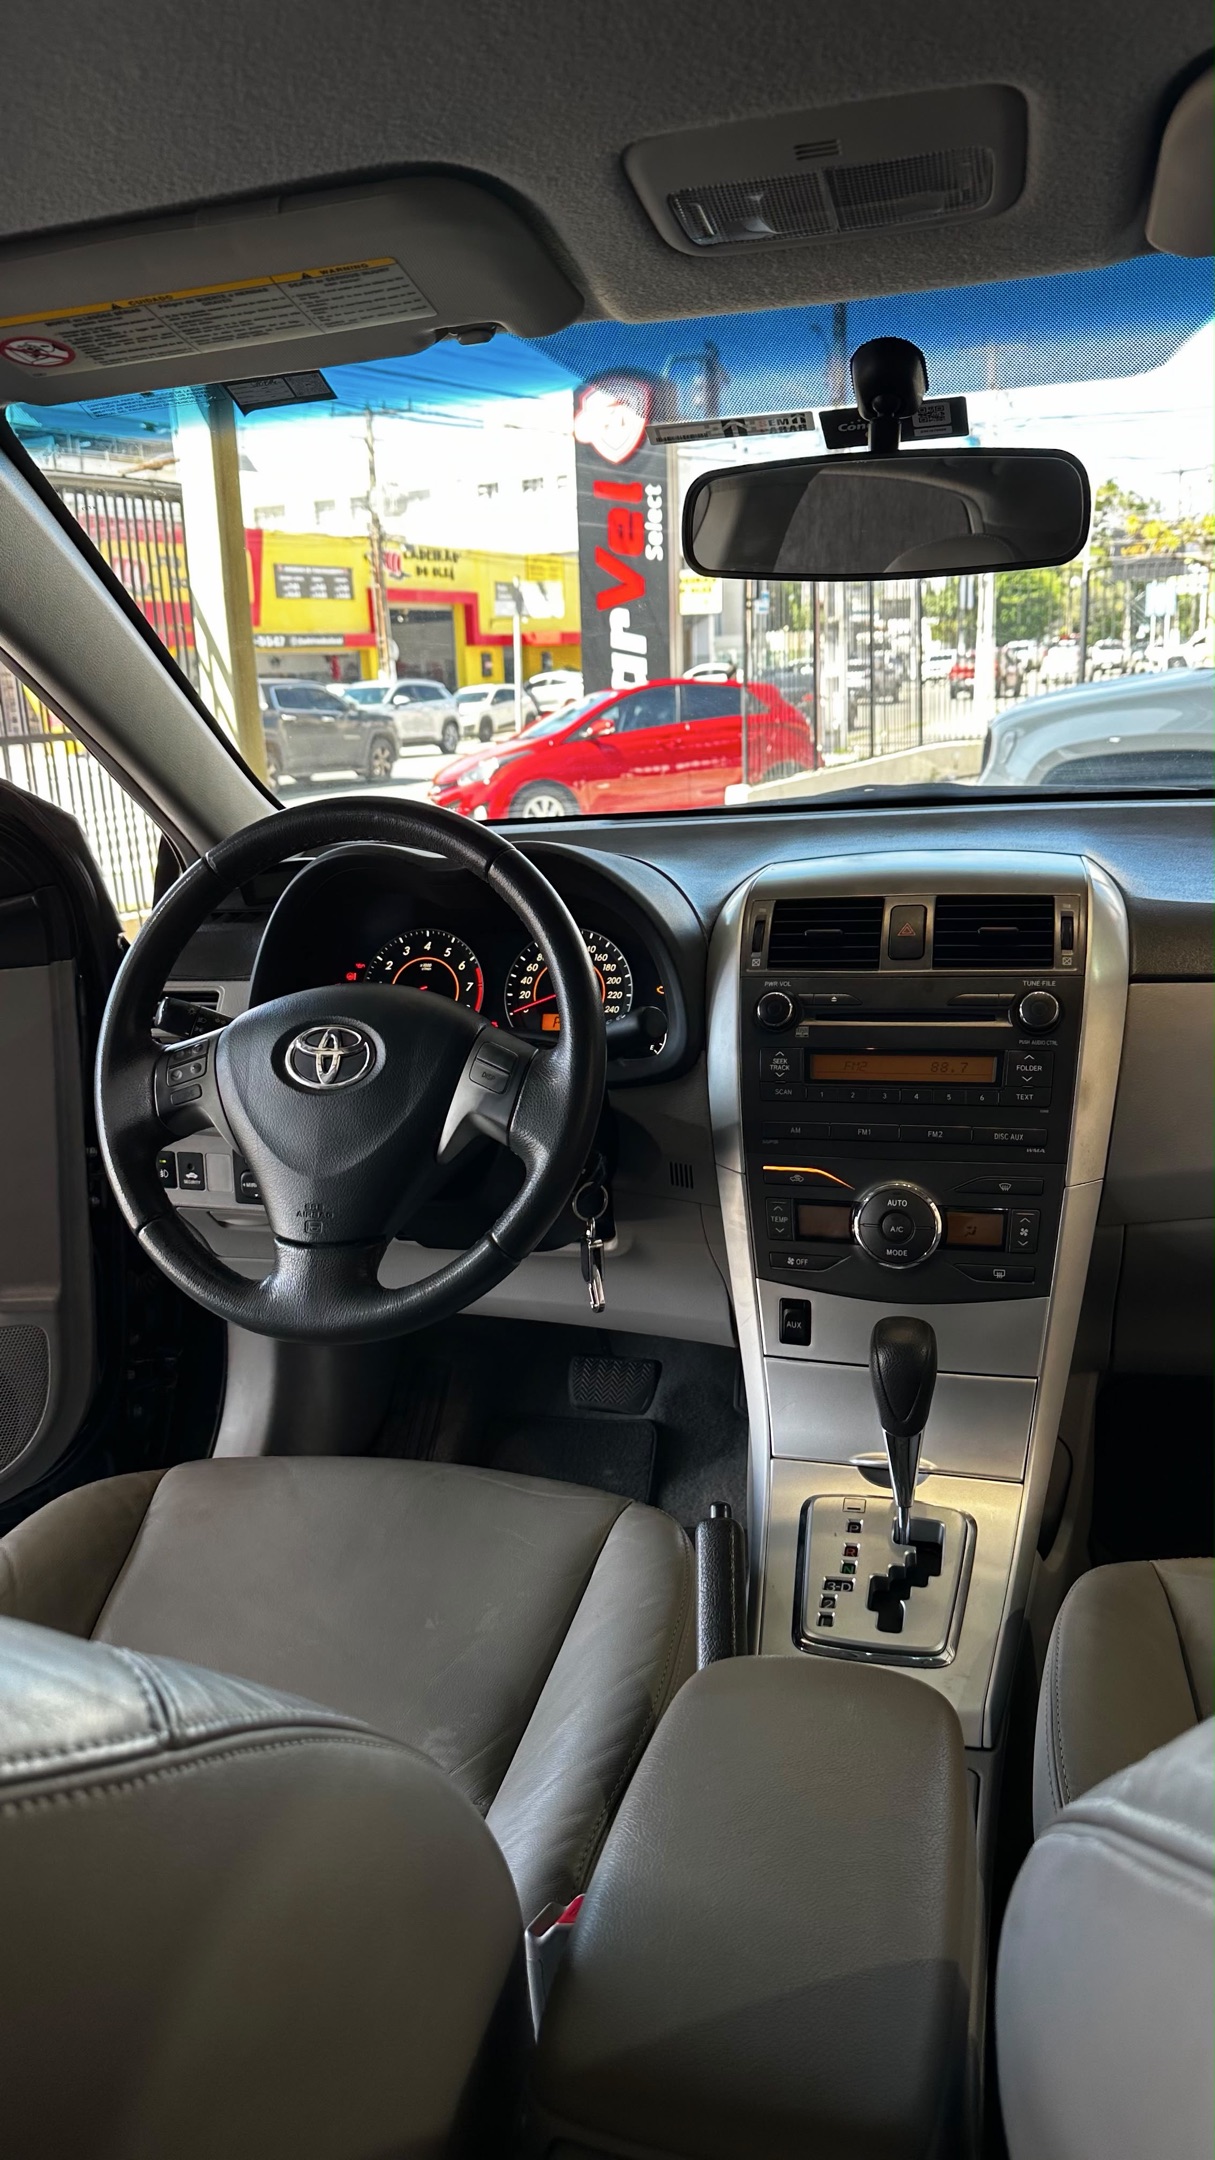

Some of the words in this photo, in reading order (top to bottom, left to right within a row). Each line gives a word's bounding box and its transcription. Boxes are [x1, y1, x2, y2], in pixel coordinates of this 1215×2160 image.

[319, 263, 369, 276] WARNING
[127, 294, 174, 306] CUIDADO
[838, 422, 869, 432] Con
[644, 483, 665, 561] Select
[402, 946, 411, 956] 3
[423, 941, 432, 952] 4
[443, 947, 452, 958] 5
[594, 953, 609, 962] 160
[384, 960, 394, 971] 2
[457, 960, 467, 971] 6
[526, 963, 539, 972] 60
[602, 963, 617, 972] 180
[520, 976, 534, 985] 40
[606, 976, 622, 985] 200
[465, 981, 475, 992] 7
[518, 990, 532, 999] 20
[607, 991, 624, 999] 220
[604, 1005, 620, 1014] 240
[772, 1057, 788, 1065] SEEK
[930, 1061, 969, 1073] 88.7
[1015, 1064, 1043, 1072] FOLDER
[481, 1071, 496, 1081] DISP
[774, 1088, 793, 1096] SCAN
[882, 1092, 888, 1100] 3
[946, 1093, 952, 1101] 5
[979, 1094, 985, 1102] 6
[1015, 1093, 1034, 1101] TEXT
[857, 1128, 871, 1136] FM1
[927, 1130, 944, 1138] FM2
[994, 1132, 1009, 1141] DISC
[1010, 1133, 1024, 1141] AUX
[887, 1199, 908, 1208] AUTO
[296, 1210, 334, 1219] AIRBAG
[890, 1226, 904, 1234] A/C
[886, 1249, 908, 1257] MODE
[796, 1258, 809, 1266] OFF
[786, 1321, 802, 1329] AUX
[846, 1548, 856, 1557] R
[844, 1564, 854, 1573] N
[826, 1581, 852, 1592] 3-D
[823, 1599, 833, 1609] 2
